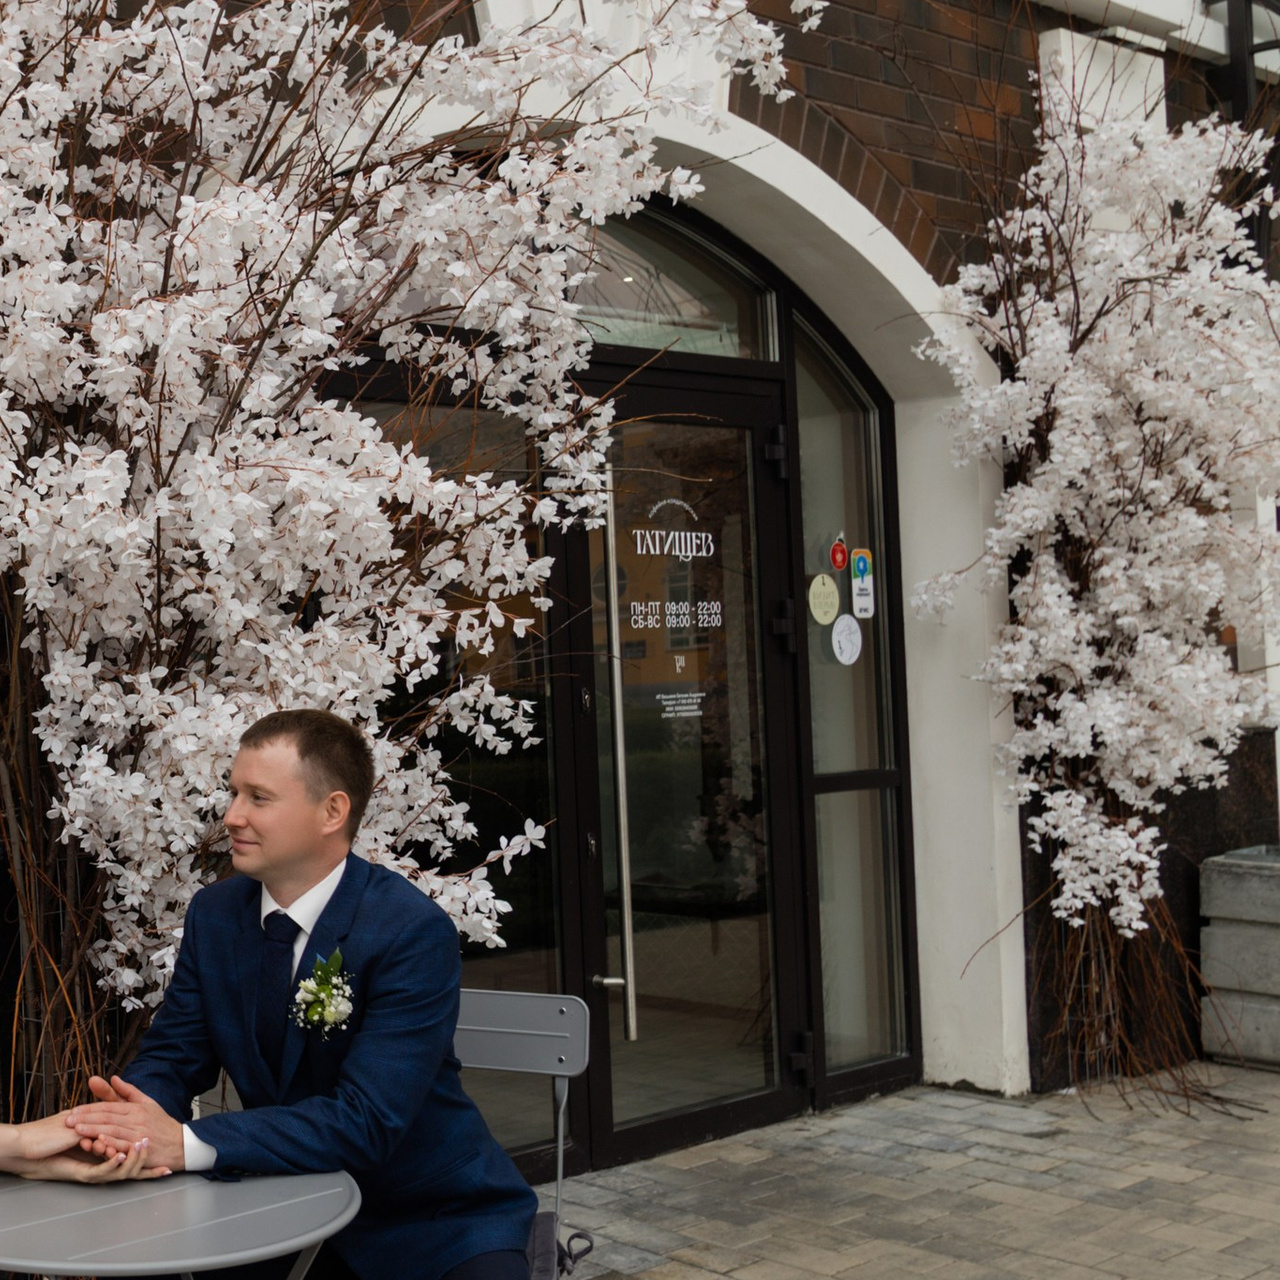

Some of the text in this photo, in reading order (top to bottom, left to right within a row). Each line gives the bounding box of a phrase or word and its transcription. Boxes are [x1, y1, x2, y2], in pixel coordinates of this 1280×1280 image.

[632, 529, 715, 562] ТАТИЩЕВ
[630, 601, 661, 615] ПН-ПТ
[665, 601, 690, 614] 09:00
[697, 601, 721, 614] 22:00
[630, 615, 661, 629] СБ-ВС
[665, 614, 690, 628] 09:00
[698, 614, 722, 627] 22:00
